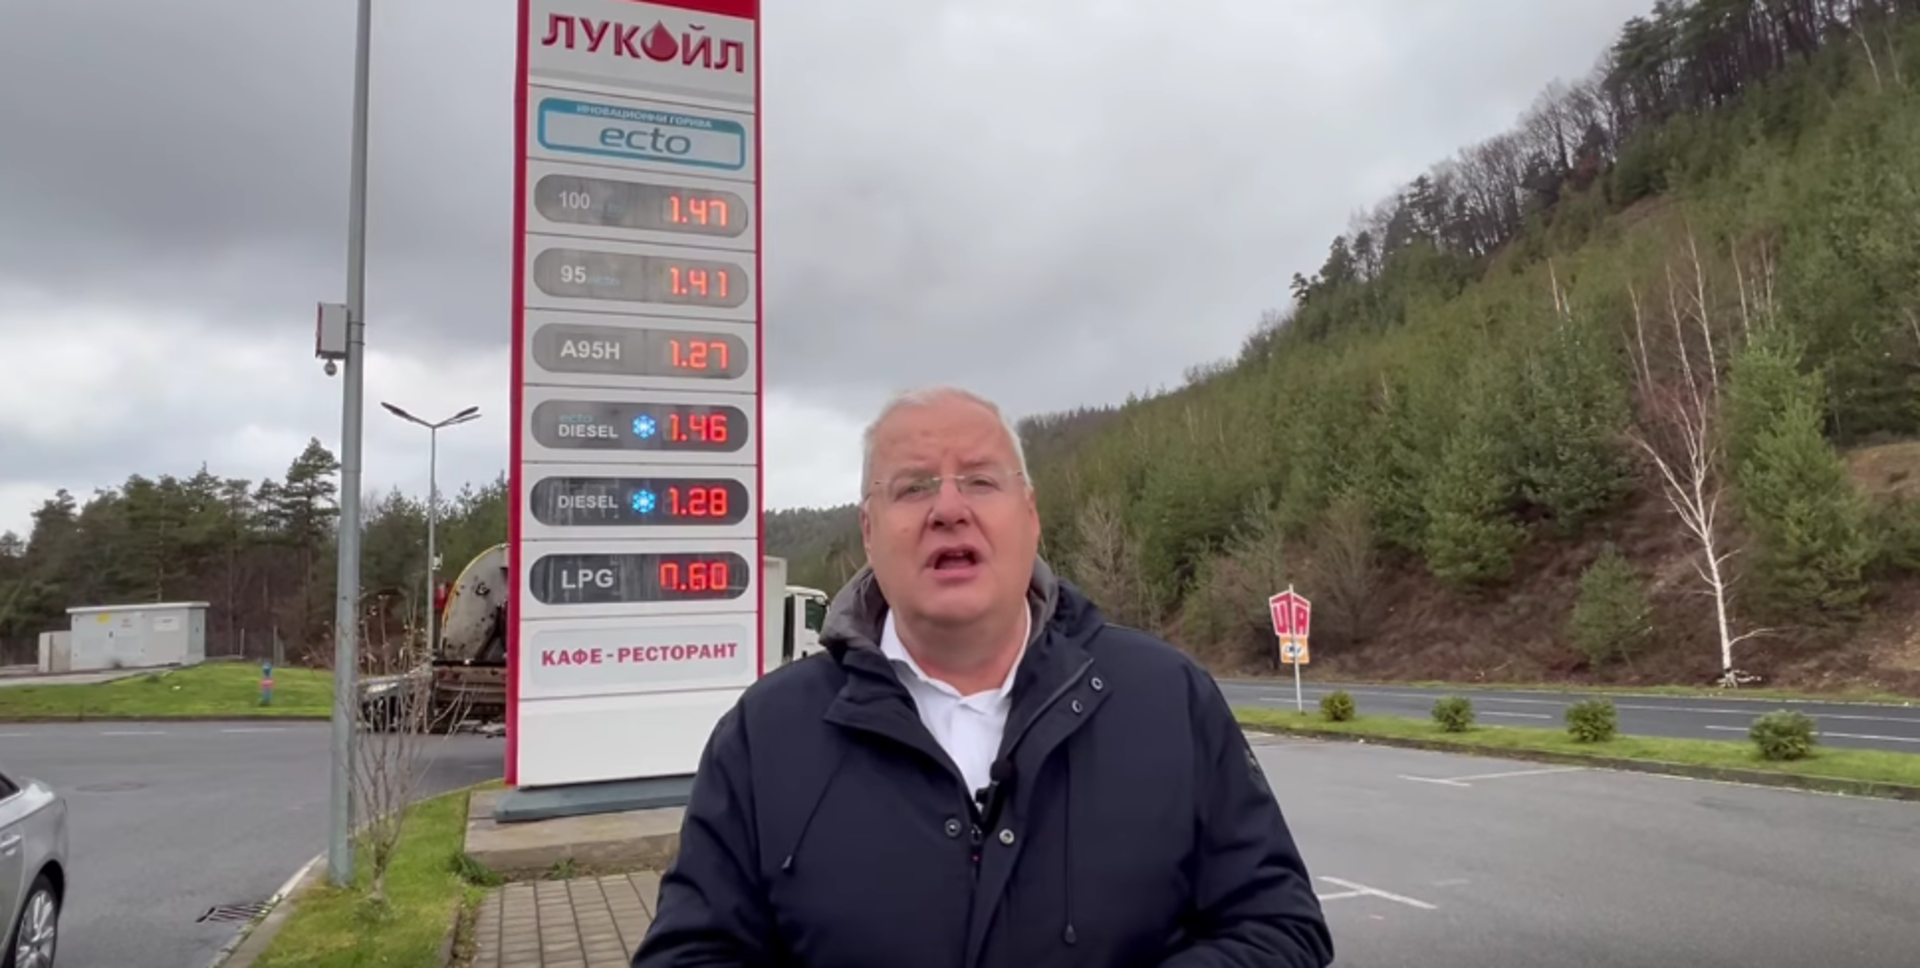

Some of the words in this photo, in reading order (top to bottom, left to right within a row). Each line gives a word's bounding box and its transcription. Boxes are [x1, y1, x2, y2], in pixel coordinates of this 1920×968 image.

[541, 13, 744, 73] ЛУКОЙЛ
[576, 104, 668, 124] ИНОВАЦИОННИ
[669, 115, 712, 129] ГОРИВА
[599, 127, 692, 156] ecto
[558, 191, 591, 210] 100
[669, 195, 729, 227] 1.47
[560, 265, 587, 284] 95
[669, 267, 728, 298] 1.41
[669, 339, 729, 370] 1.27
[558, 423, 619, 439] DIESEL
[669, 413, 728, 443] 1.46
[557, 494, 619, 509] DIESEL
[668, 487, 728, 517] 1.28
[561, 568, 614, 590] LPG
